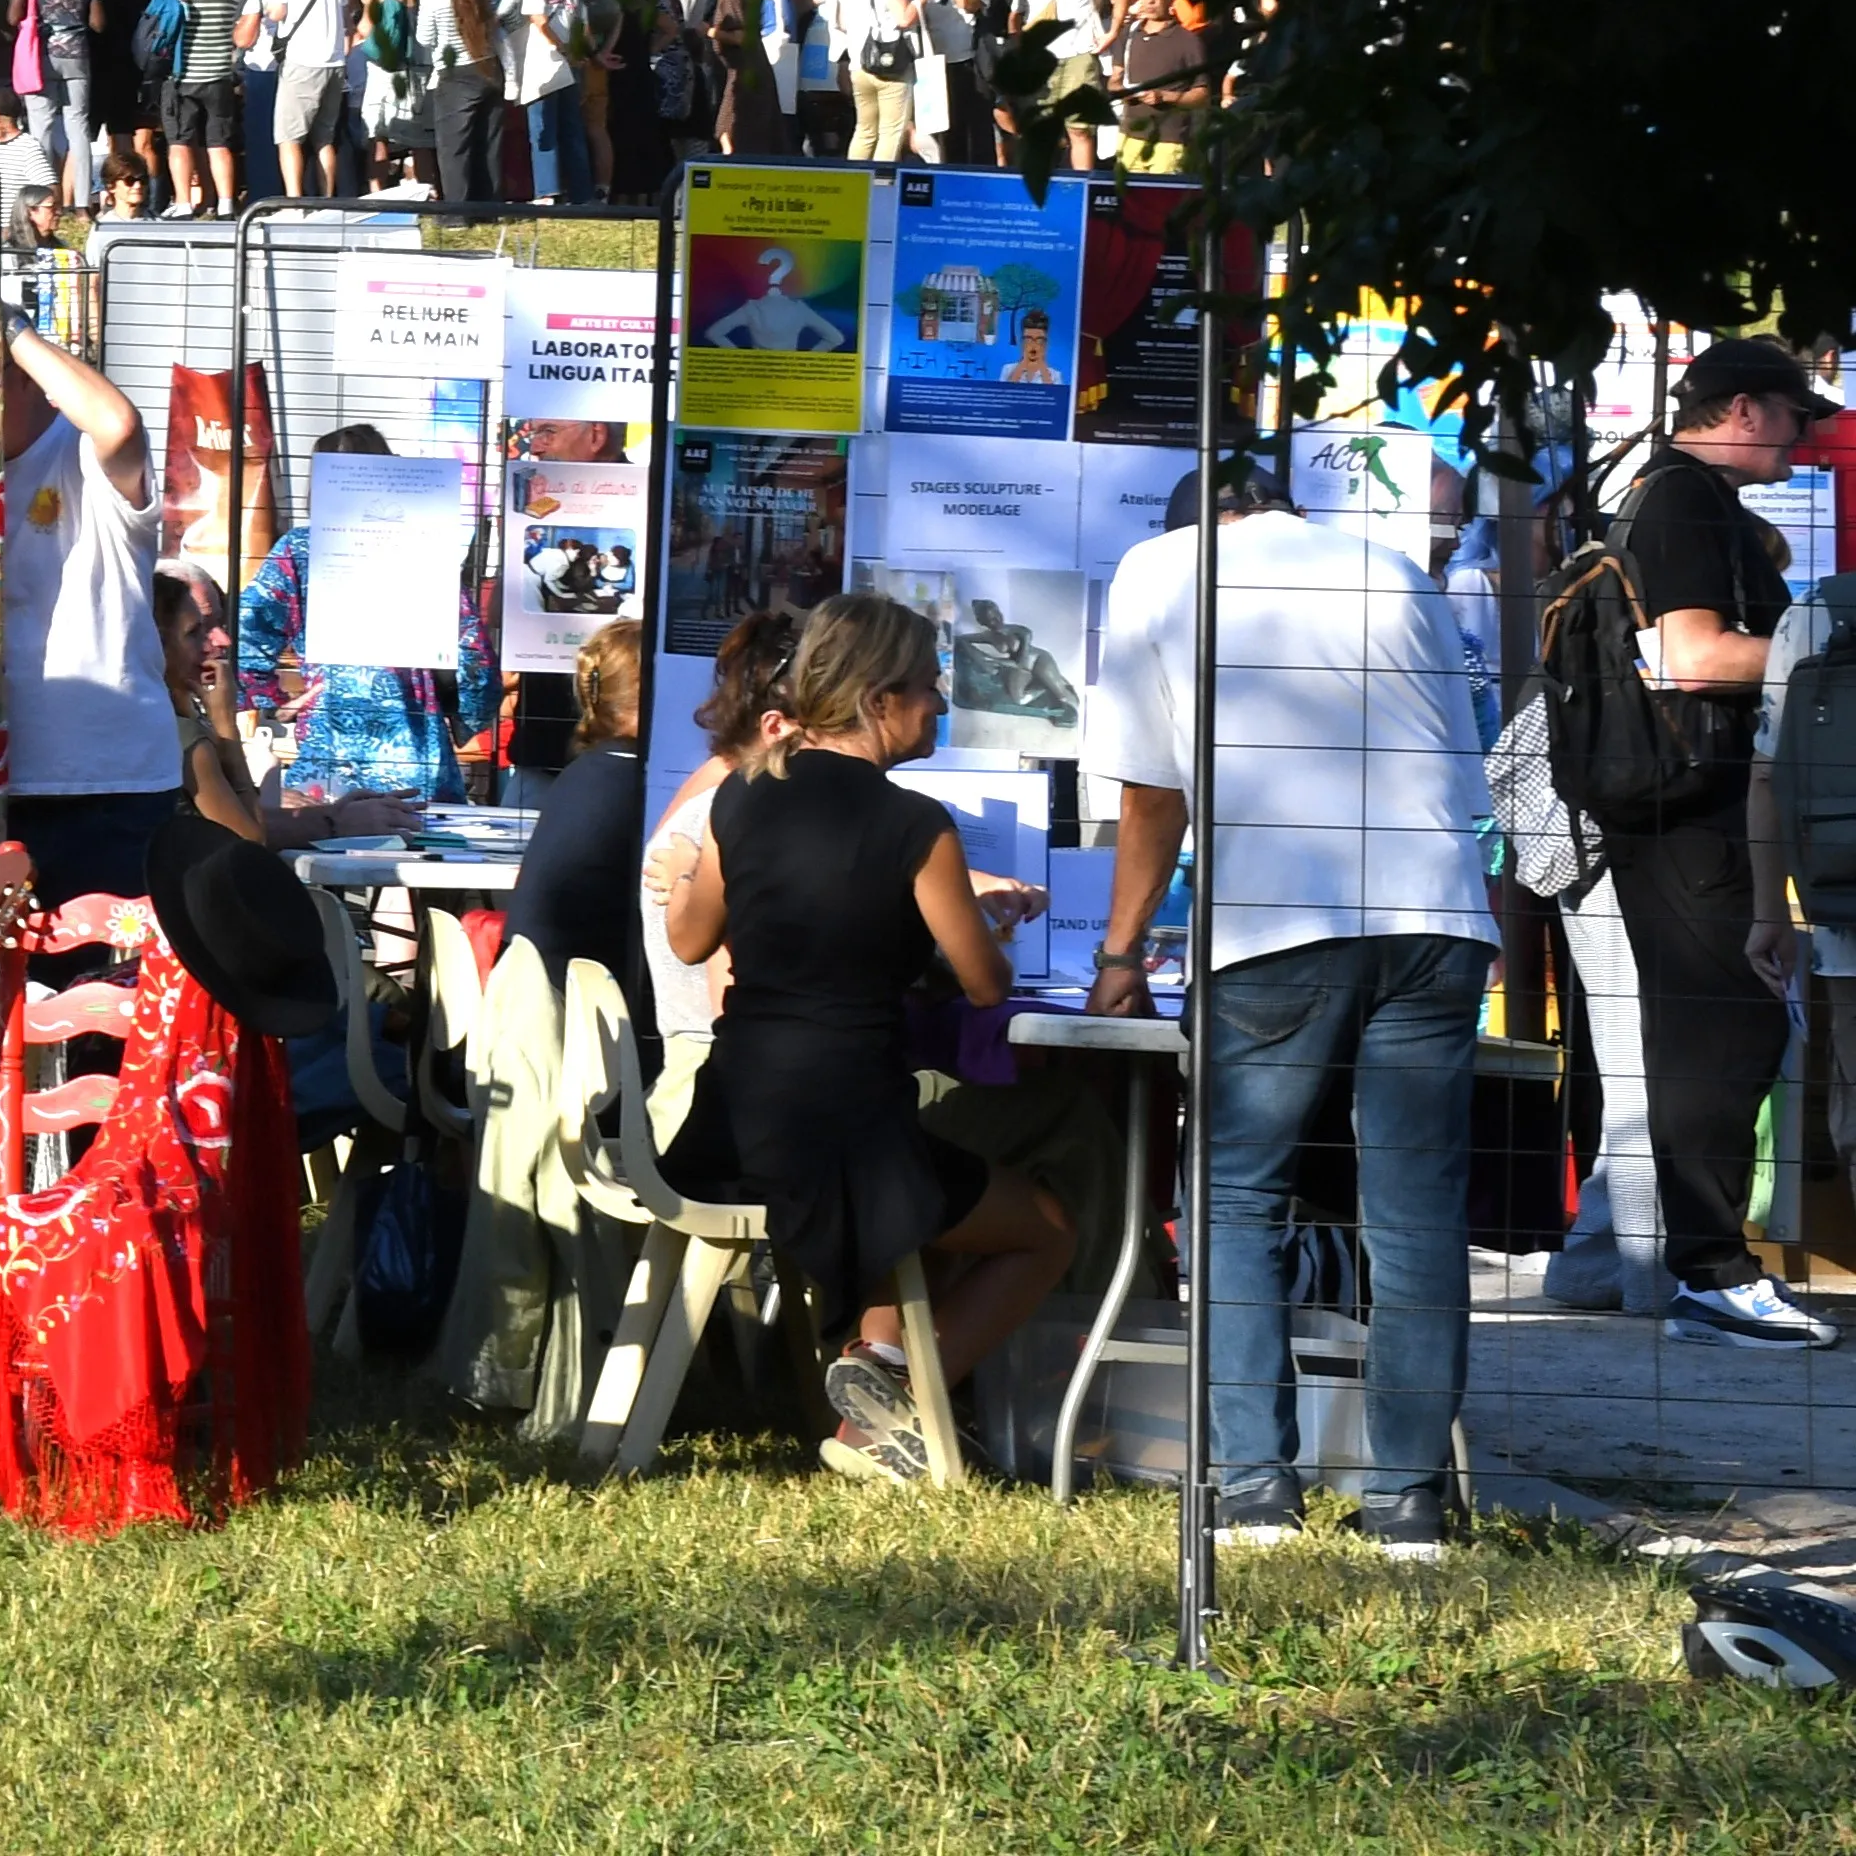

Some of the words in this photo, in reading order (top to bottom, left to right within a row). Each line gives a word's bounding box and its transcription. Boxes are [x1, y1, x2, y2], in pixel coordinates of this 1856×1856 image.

[906, 182, 931, 193] AAE
[749, 196, 765, 214] Psy
[383, 304, 469, 323] RELIURE
[570, 317, 601, 328] ARTS
[603, 318, 618, 329] ET
[370, 329, 383, 343] A
[391, 330, 416, 345] LA
[424, 331, 479, 346] MAIN
[528, 364, 606, 382] LINGUA
[724, 484, 774, 498] PLAISIR
[910, 482, 960, 494] STAGES
[964, 482, 1042, 495] SCULPTURE
[943, 503, 1021, 516] MODELAGE
[1050, 918, 1088, 931] TAND
